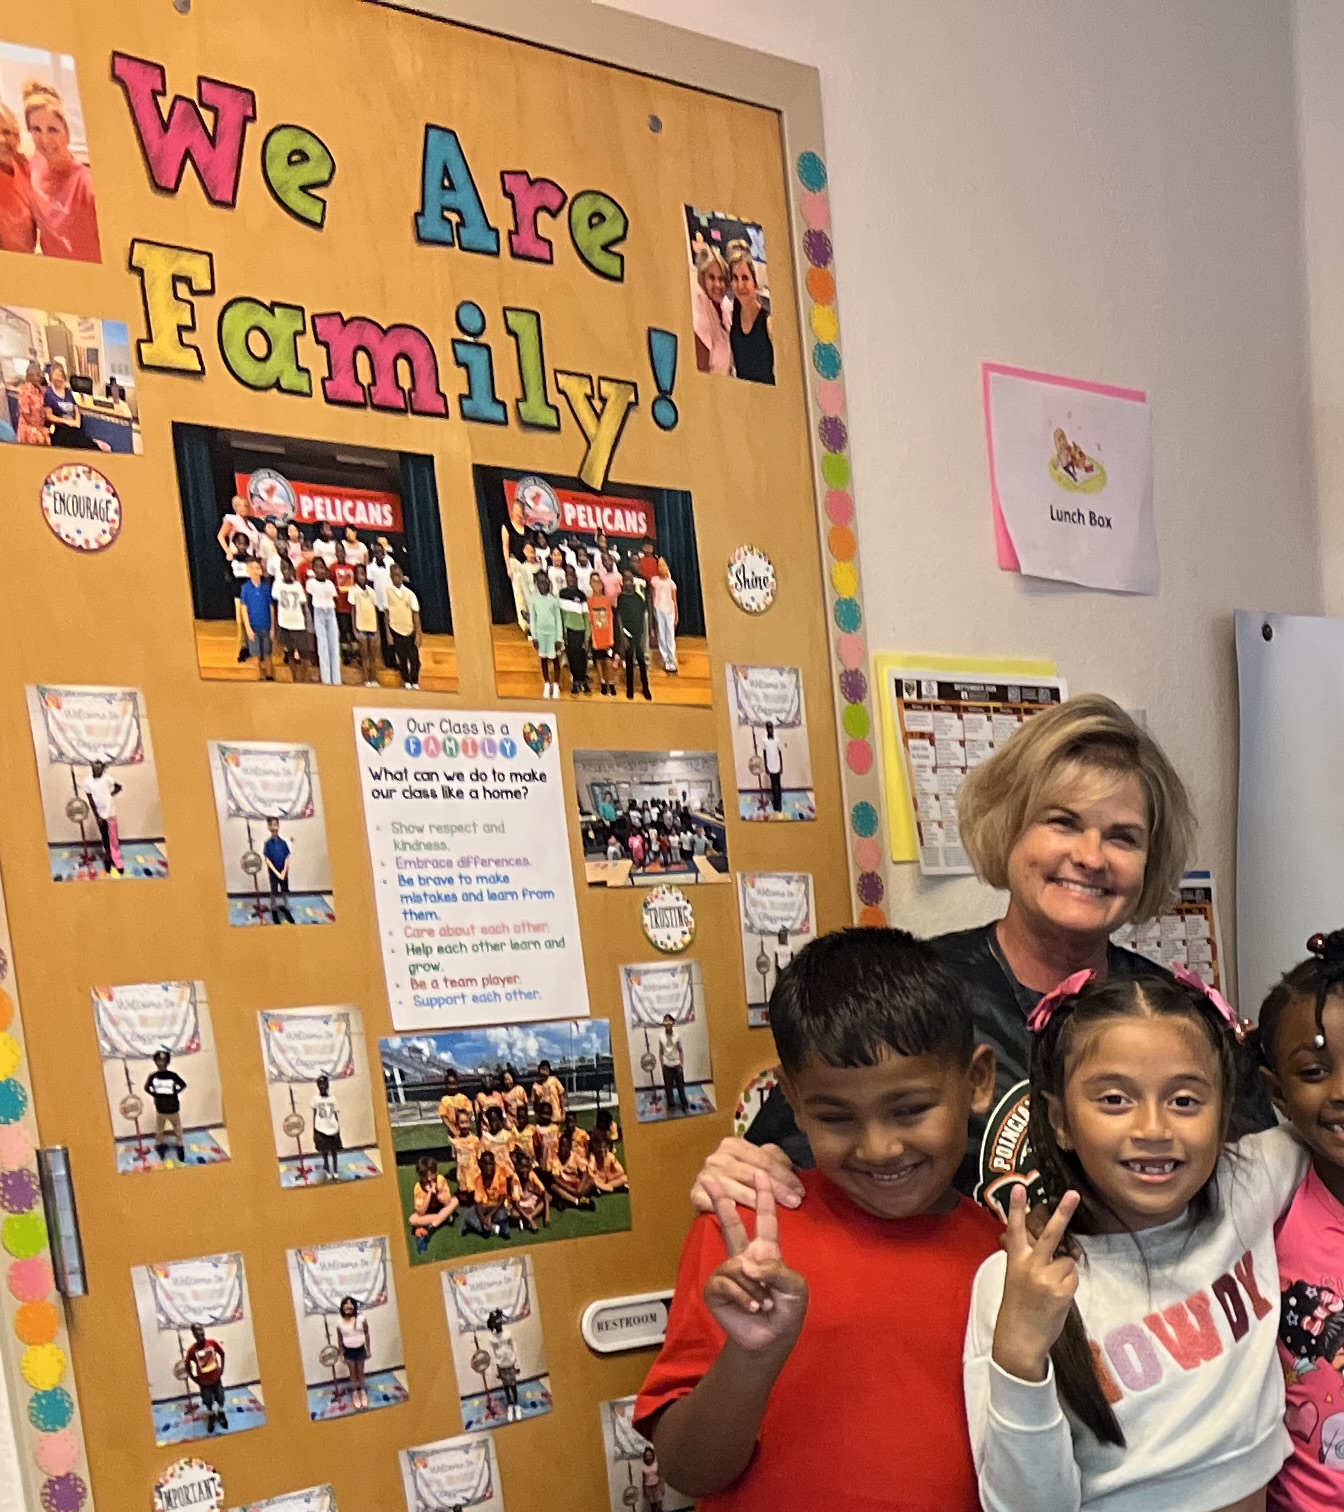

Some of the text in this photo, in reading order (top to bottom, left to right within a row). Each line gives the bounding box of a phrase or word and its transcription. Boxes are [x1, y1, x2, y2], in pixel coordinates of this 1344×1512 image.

[111, 50, 629, 282] We Are
[129, 238, 679, 490] Family!
[52, 491, 112, 523] ENCOURAGE
[300, 495, 393, 527] PELICANS
[1050, 504, 1113, 529] Lunch Box
[562, 502, 647, 534] PELICANS
[734, 571, 769, 592] Shine
[406, 718, 435, 734] Our
[440, 718, 478, 735] Class
[500, 724, 510, 736] a
[405, 736, 516, 758] FAMILY
[368, 767, 547, 783] What can we do to make
[371, 786, 529, 800] our class like a home?
[391, 821, 505, 836] Show respect and
[395, 857, 453, 870] Embrace
[398, 872, 510, 886] Be brave to make
[400, 888, 555, 905] mistakes and learn from
[650, 905, 690, 930] TRUSTING
[404, 925, 435, 939] Care
[439, 923, 477, 938] about
[480, 922, 511, 935] each
[406, 936, 566, 957] Help each other learn and
[410, 977, 427, 991] Be
[431, 979, 439, 990] a
[443, 976, 478, 989] team
[413, 993, 468, 1009] Support
[472, 990, 501, 1003] each
[596, 1312, 658, 1332] RESTROOM
[160, 1477, 216, 1512] IMPORTANT
